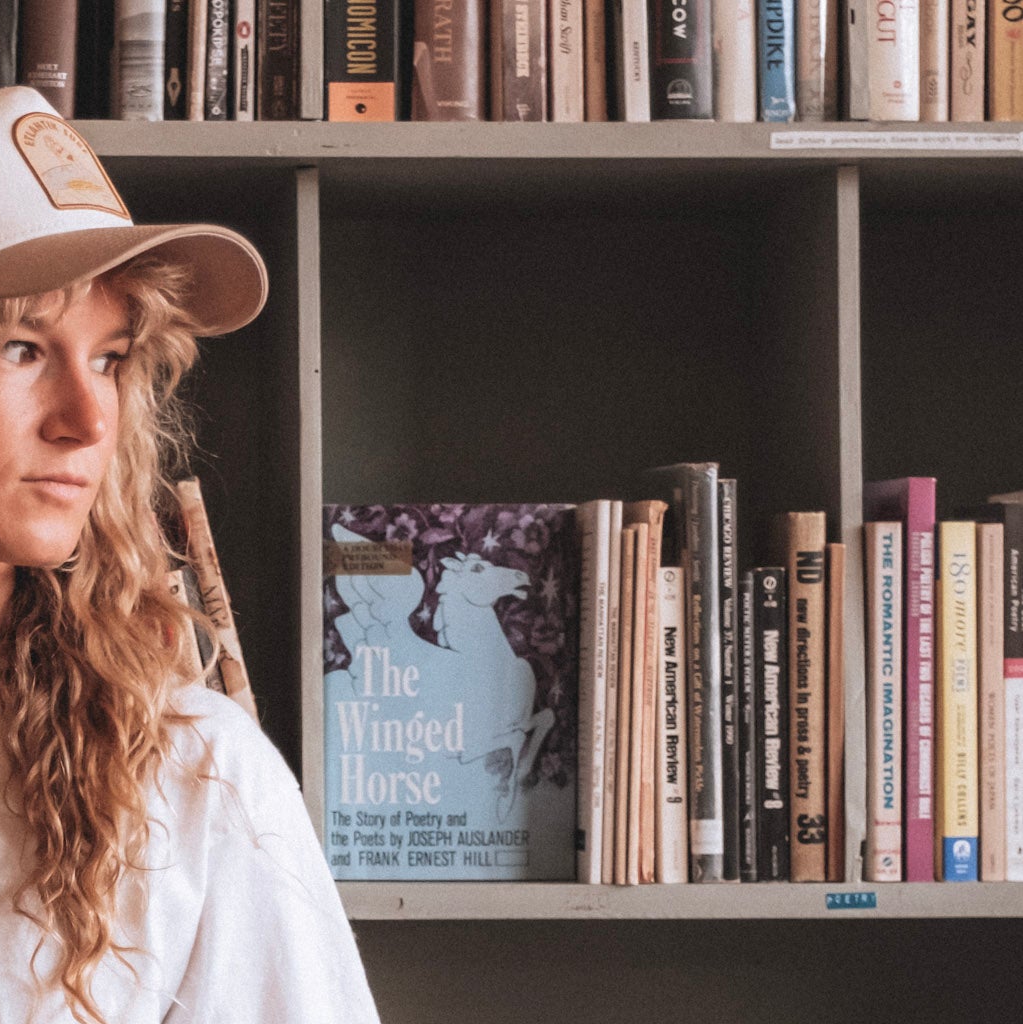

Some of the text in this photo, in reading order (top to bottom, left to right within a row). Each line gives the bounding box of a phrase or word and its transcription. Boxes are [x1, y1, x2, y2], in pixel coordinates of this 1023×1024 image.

[559, 25, 572, 55] Swift
[722, 496, 733, 544] CHICAGO
[722, 545, 733, 589] REVIEW
[797, 551, 823, 585] ND
[882, 532, 893, 569] THE
[948, 552, 972, 595] 180
[1009, 548, 1020, 632] American Poetry
[882, 575, 893, 676] ROMANTIC
[919, 603, 932, 615] OF
[919, 617, 932, 634] THE
[955, 600, 967, 652] more
[919, 636, 932, 659] LAST
[356, 645, 421, 698] The
[664, 626, 679, 785] New American Review
[763, 628, 781, 790] New American Review
[794, 598, 812, 800] new directions in prose & poetry
[334, 702, 465, 764] Winged
[882, 682, 894, 810] IMAGINATION
[919, 725, 932, 737] OF
[340, 754, 443, 805] Horse
[957, 752, 967, 780] BILLY
[331, 811, 467, 830] The Story of Poetry and
[957, 784, 968, 827] COLLINS
[331, 830, 530, 849] the Poets by JOSEPH AUSLANDER
[796, 814, 826, 845] 33
[331, 850, 493, 867] and FRANK ERNEST HILL
